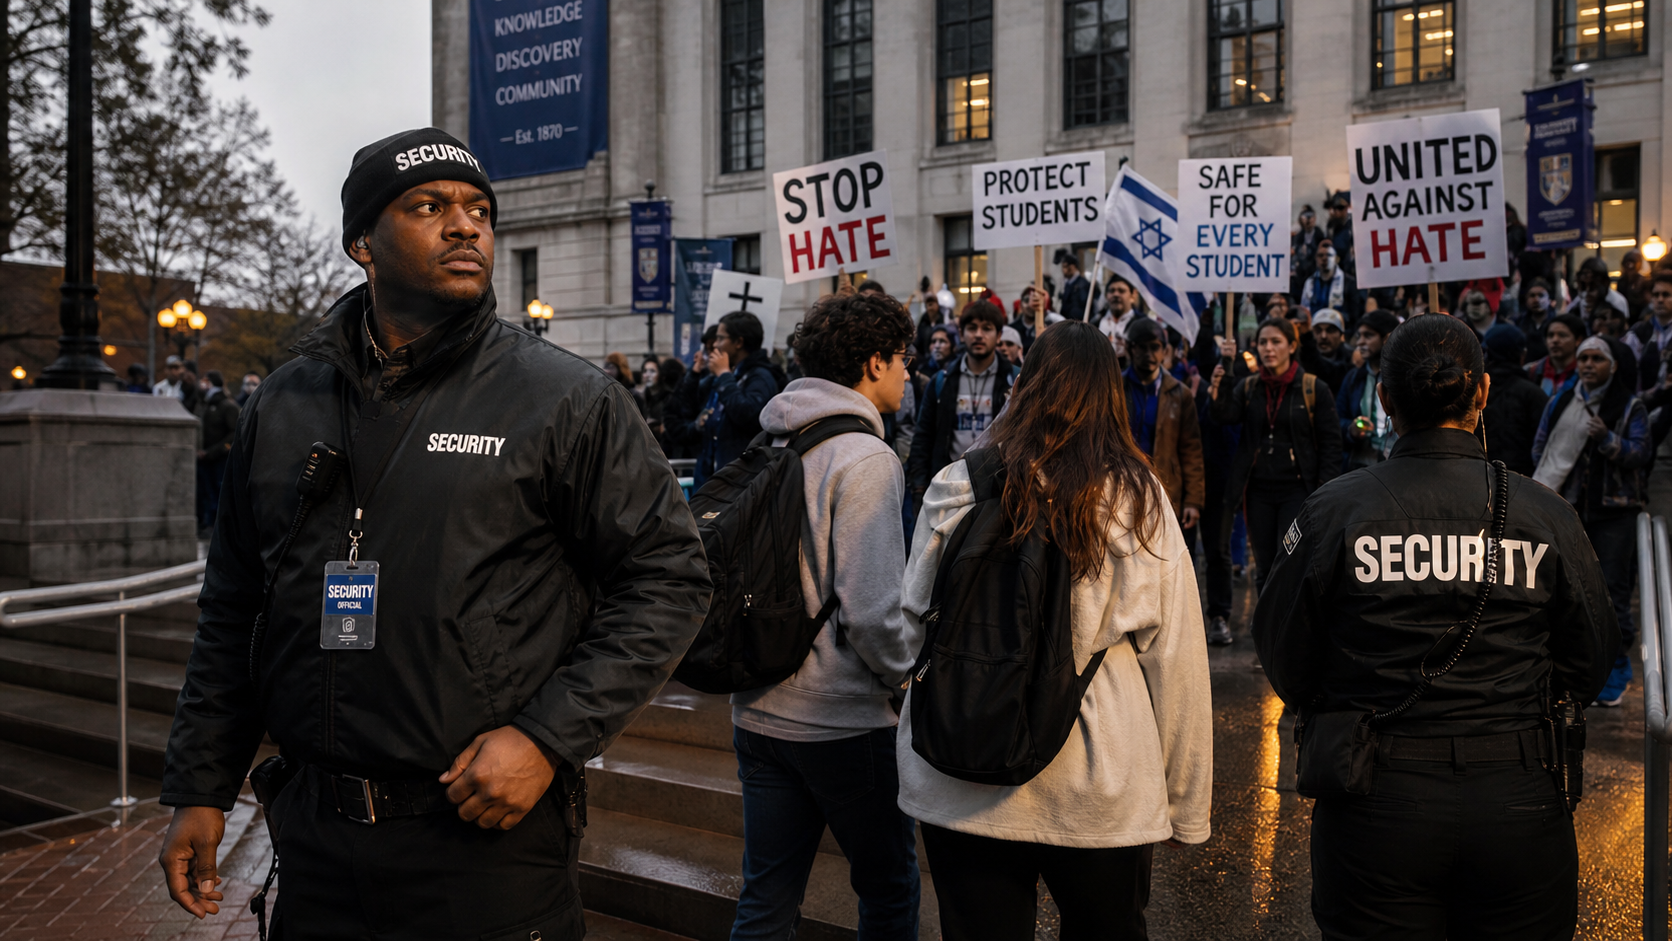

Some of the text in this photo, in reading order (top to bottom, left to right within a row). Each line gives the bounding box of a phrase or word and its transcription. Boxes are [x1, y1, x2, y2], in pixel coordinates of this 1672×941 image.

[494, 0, 583, 37] KNOWLEDGE
[495, 37, 583, 73] DISCOVERY
[495, 74, 583, 106] COMMUNITY
[515, 123, 563, 145] Est. 1870
[395, 143, 482, 173] SECURITY
[1355, 134, 1498, 185] UNITED
[783, 161, 884, 224] STOP
[983, 161, 1091, 196] PROTECT
[1198, 163, 1262, 190] SAFE
[981, 196, 1099, 230] STUDENTS
[1209, 193, 1258, 219] FOR
[1361, 180, 1494, 222] AGAINST
[788, 214, 891, 274] HATE
[1196, 223, 1274, 248] EVERY
[1370, 219, 1487, 269] HATE
[1186, 253, 1286, 279] STUDENT
[427, 432, 506, 457] SECURITY
[328, 584, 374, 599] SECURITY
[337, 601, 362, 610] OFFICIAL
